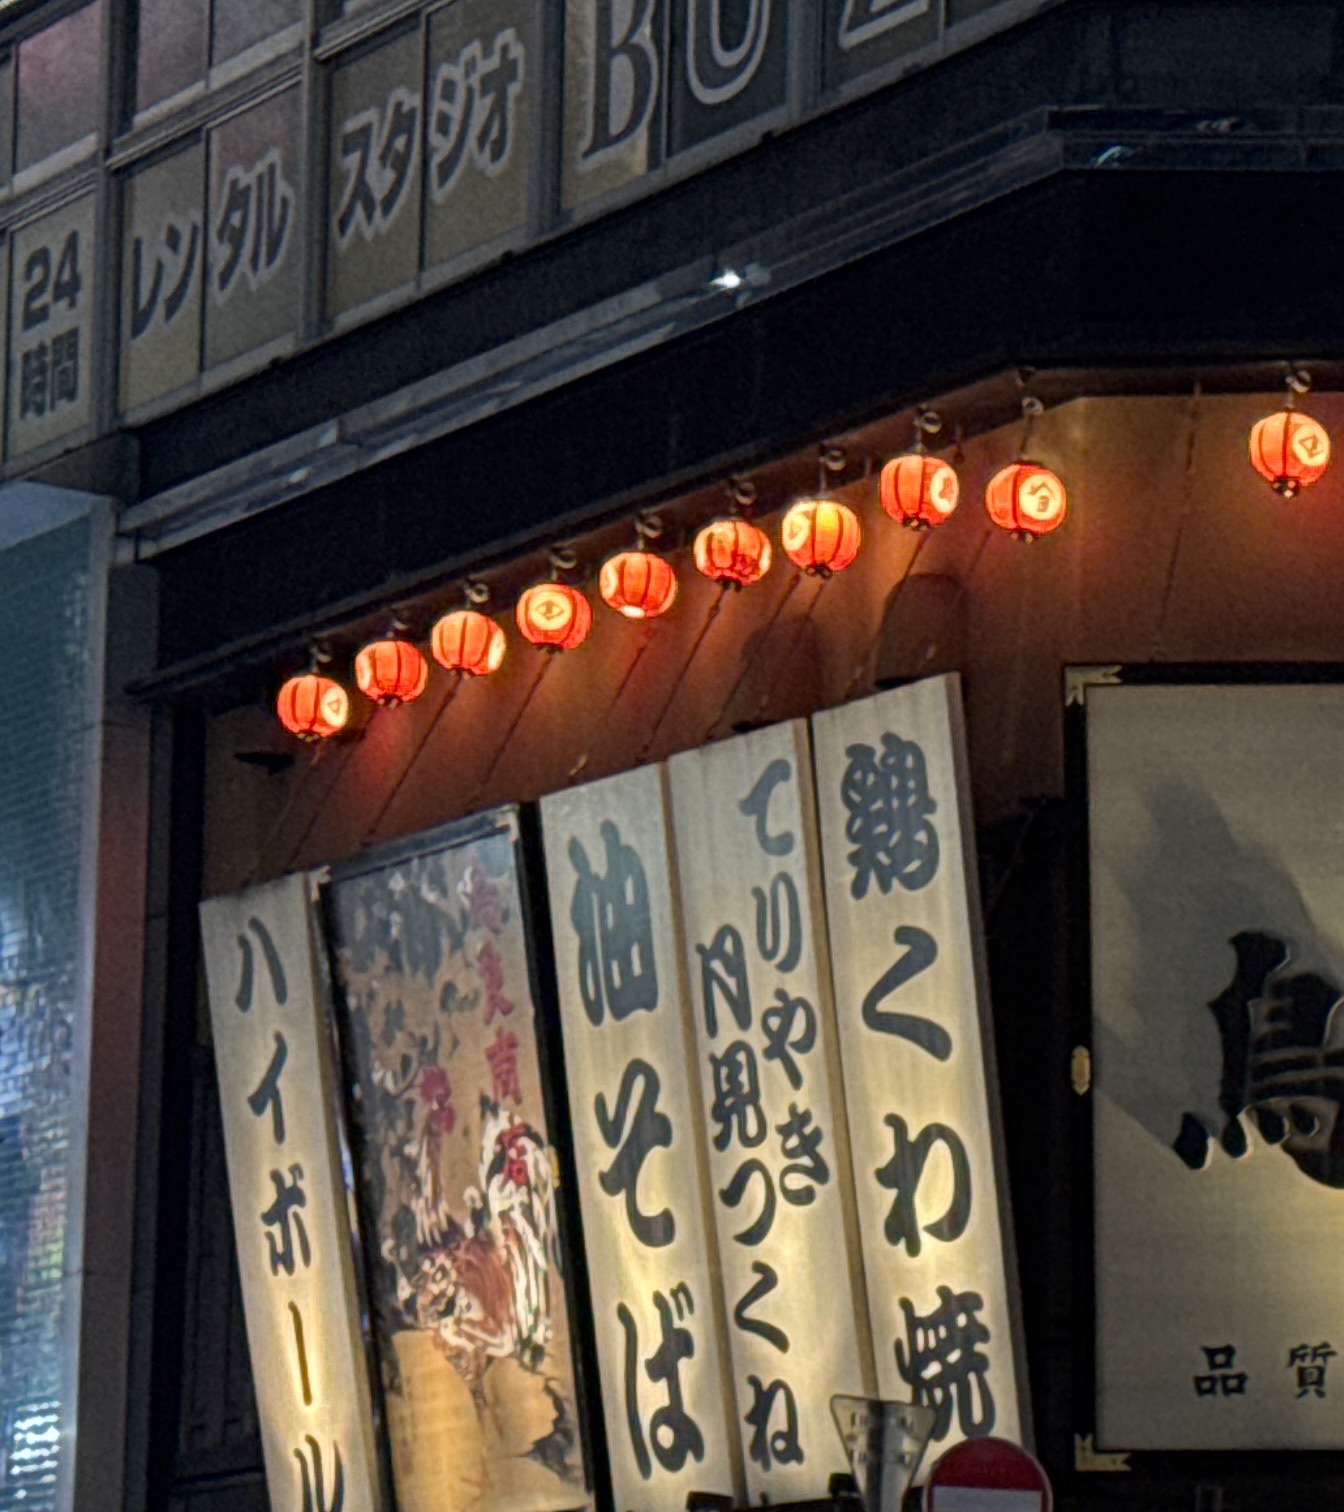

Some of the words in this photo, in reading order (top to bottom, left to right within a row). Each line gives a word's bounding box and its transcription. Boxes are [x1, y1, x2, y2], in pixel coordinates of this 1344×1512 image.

[131, 152, 292, 340] レンタル
[338, 28, 524, 240] スタジオ
[576, 0, 940, 168] BU
[20, 327, 81, 416] 時間
[22, 231, 82, 328] 24
[740, 757, 832, 1206] てりやき
[568, 820, 706, 1480] 油そば
[696, 923, 806, 1472] 月見つくね
